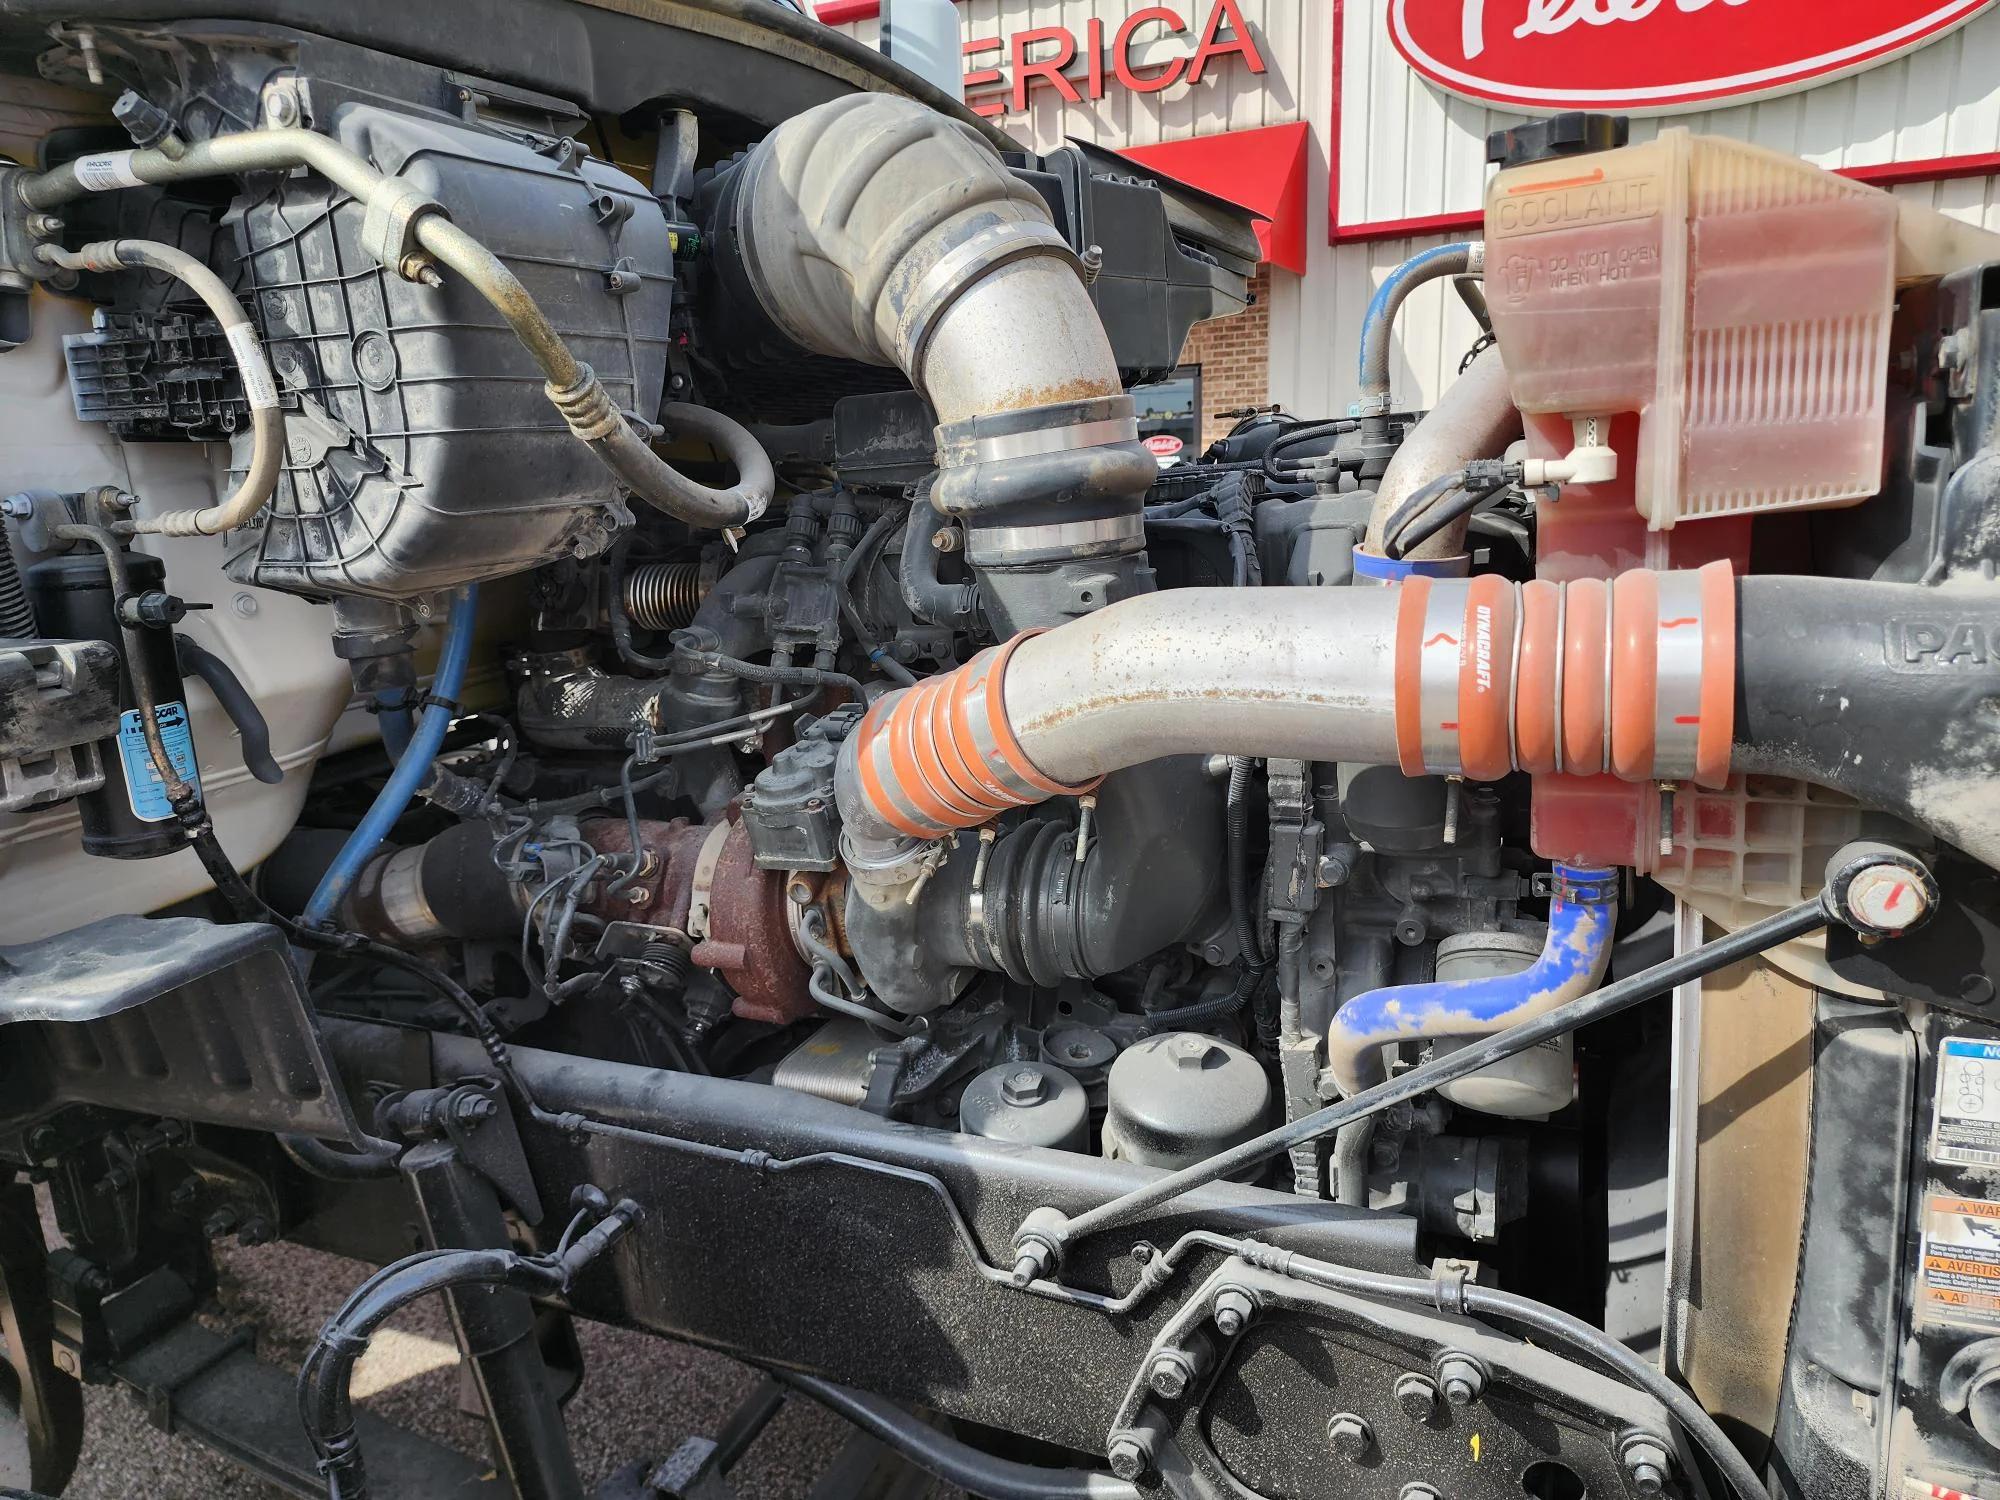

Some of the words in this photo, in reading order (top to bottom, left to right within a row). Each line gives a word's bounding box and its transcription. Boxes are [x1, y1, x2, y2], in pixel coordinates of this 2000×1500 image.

[1500, 183, 1649, 231] COOLANT
[1550, 256, 1569, 272] DO
[1578, 250, 1609, 268] NOT
[1618, 243, 1660, 263] OPEN
[1550, 270, 1589, 289] WHEN
[1600, 265, 1632, 282] HOT
[1902, 622, 2000, 664] PA
[133, 706, 179, 723] PCCAR
